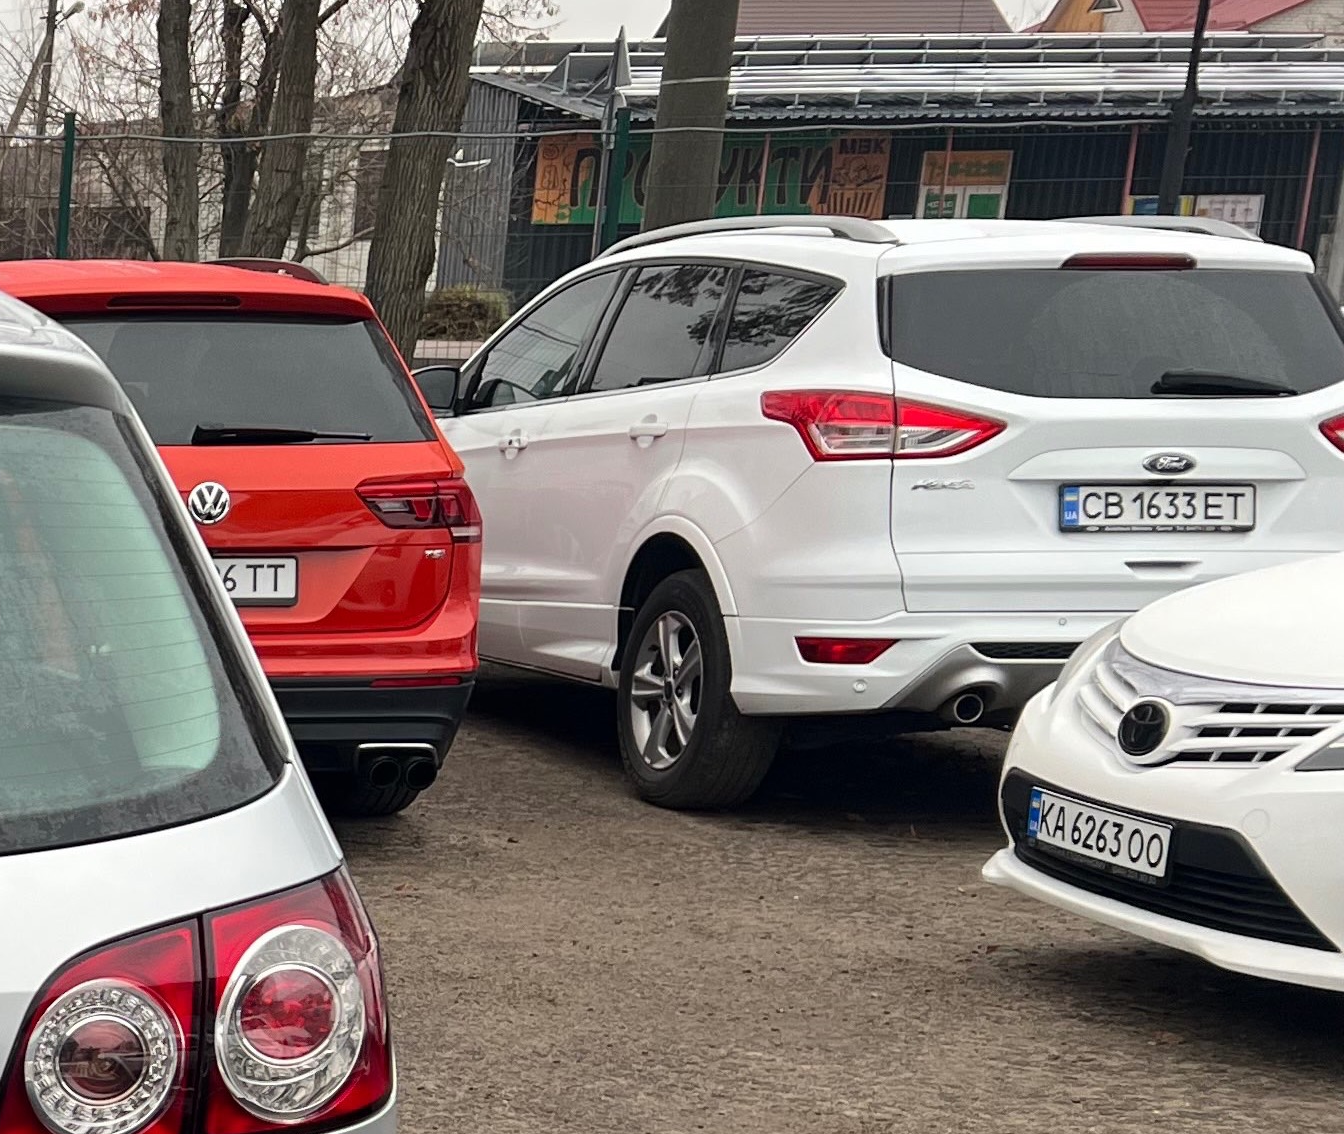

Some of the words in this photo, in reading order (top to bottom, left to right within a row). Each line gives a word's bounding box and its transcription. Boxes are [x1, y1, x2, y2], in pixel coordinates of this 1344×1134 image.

[1081, 491, 1125, 521] CB
[1132, 491, 1197, 521] 1633
[1203, 492, 1247, 520] ET
[214, 564, 237, 592] 6
[245, 563, 286, 592] TT
[1040, 799, 1066, 842] KA
[1070, 811, 1124, 858] 6263
[1128, 828, 1163, 868] OO
